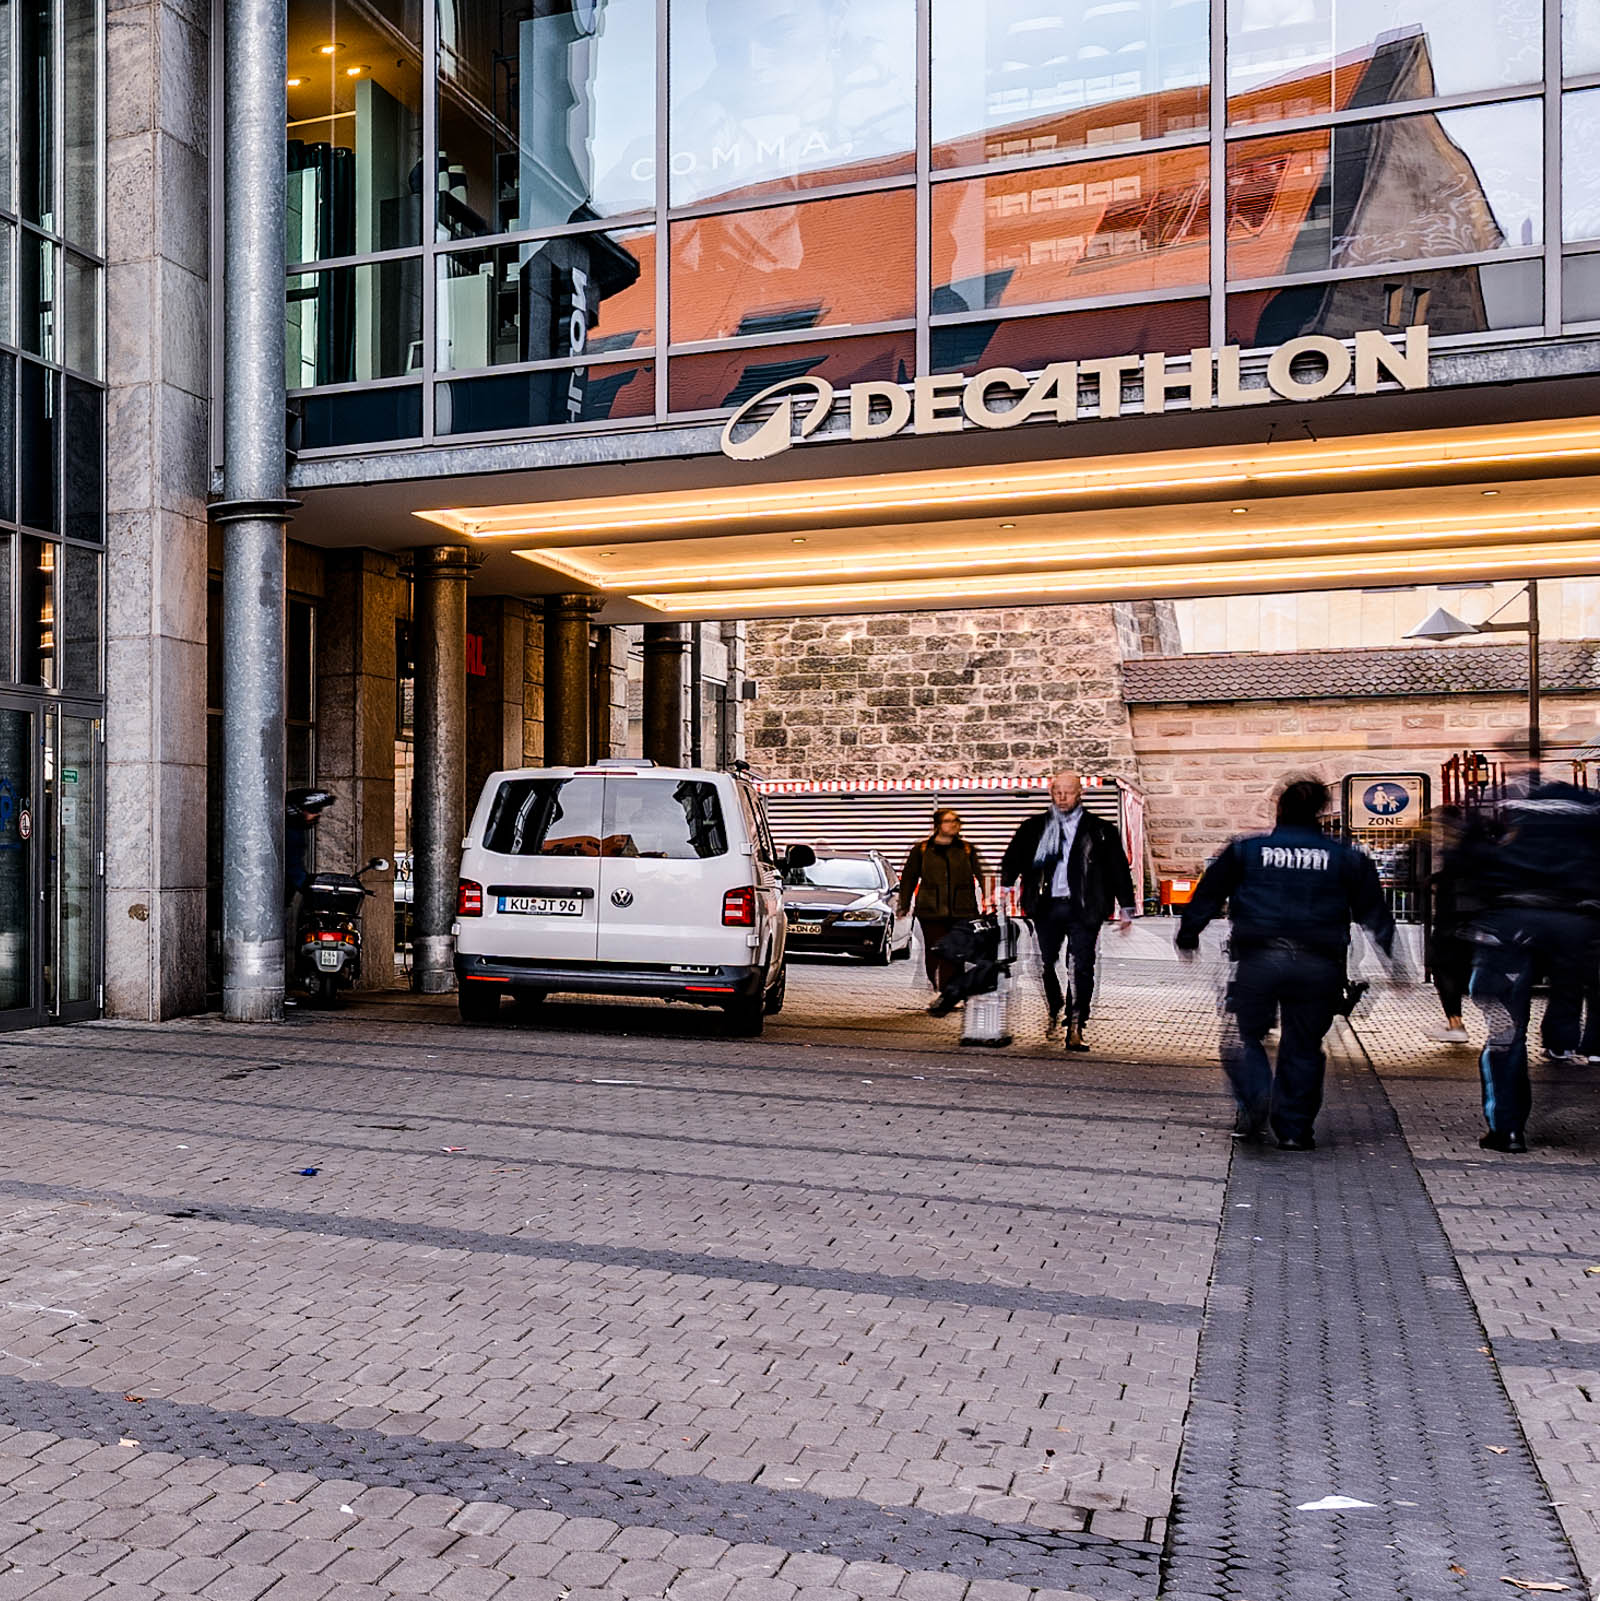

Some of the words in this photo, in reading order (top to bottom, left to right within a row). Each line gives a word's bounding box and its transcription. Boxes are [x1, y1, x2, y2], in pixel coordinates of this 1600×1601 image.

[850, 324, 1429, 441] DECATHLON
[1368, 817, 1403, 826] ZONE
[1261, 846, 1330, 871] POLIZEI
[510, 898, 529, 910] KU
[538, 900, 556, 911] JT
[559, 900, 576, 912] 96
